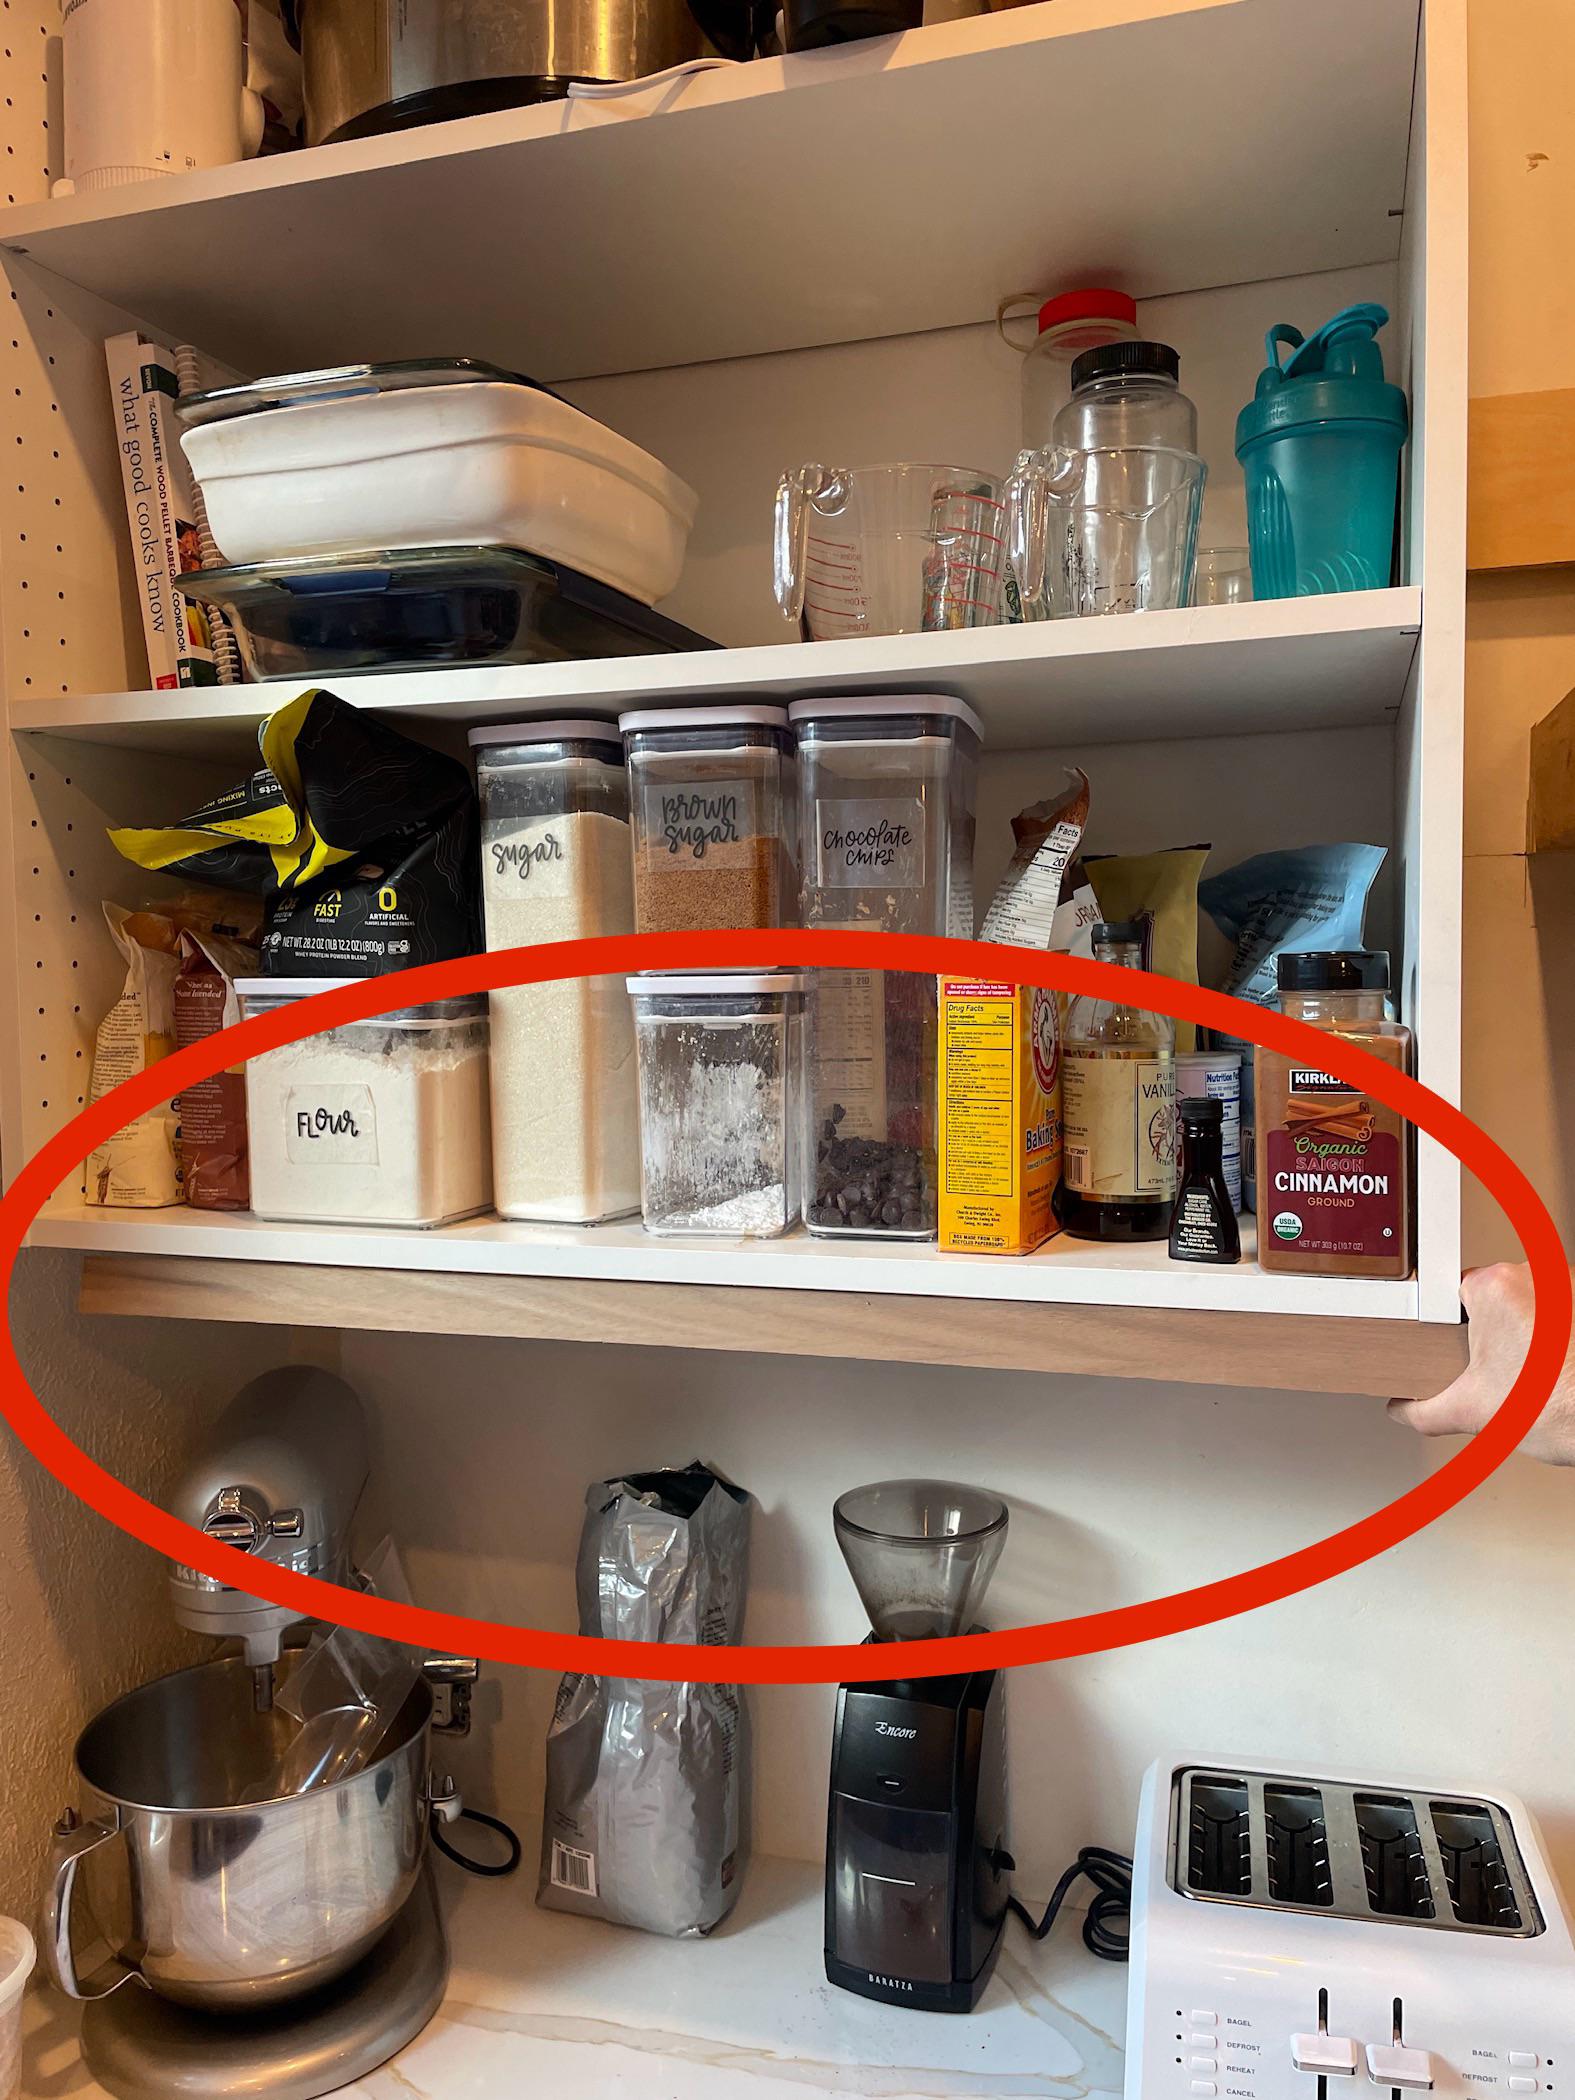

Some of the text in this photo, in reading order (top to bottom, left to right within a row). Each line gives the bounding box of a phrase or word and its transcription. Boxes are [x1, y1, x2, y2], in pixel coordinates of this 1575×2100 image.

[149, 412, 163, 463] COMPLETE
[156, 465, 167, 499] WOOD
[119, 376, 165, 633] what good cooks know
[160, 502, 171, 536] PELLET
[165, 538, 177, 590] BARBEQ
[171, 592, 187, 653] COOKBOOK
[259, 784, 283, 794] cts
[217, 790, 246, 804] MIXING
[1058, 825, 1079, 838] Facts
[1052, 857, 1065, 867] 20
[378, 887, 397, 912] 0
[314, 904, 342, 917] FAST
[369, 913, 410, 921] ARTIFICIAL
[282, 936, 293, 948] NET
[303, 937, 316, 949] 28.2
[316, 938, 325, 950] OZ
[338, 939, 350, 951] 12.2
[351, 940, 362, 953] OZ)
[362, 941, 385, 955] (800g)
[948, 1004, 984, 1013] Drug Facts
[1206, 1073, 1232, 1082] Nutrition
[1295, 1072, 1347, 1085] KIRKL
[1142, 1083, 1176, 1098] VANIL
[1026, 1122, 1054, 1151] Baking
[1294, 1136, 1368, 1157] Organic
[1295, 1157, 1364, 1173] SAIGON
[1274, 1172, 1389, 1195] CINNAMON
[1307, 1197, 1355, 1208] GROUND
[1299, 1240, 1310, 1248] NET
[1311, 1240, 1320, 1248] WT
[1321, 1241, 1332, 1249] 303
[875, 1721, 917, 1739] Encore
[868, 1973, 913, 1992] BARATZA
[1226, 2018, 1252, 2026] BAGEL
[1226, 2041, 1261, 2052] DEFROST
[1472, 2049, 1498, 2059] BAGEL
[1226, 2065, 1255, 2074] REHEAT
[1462, 2073, 1498, 2083] DEFROST
[1226, 2088, 1256, 2098] CANCEL
